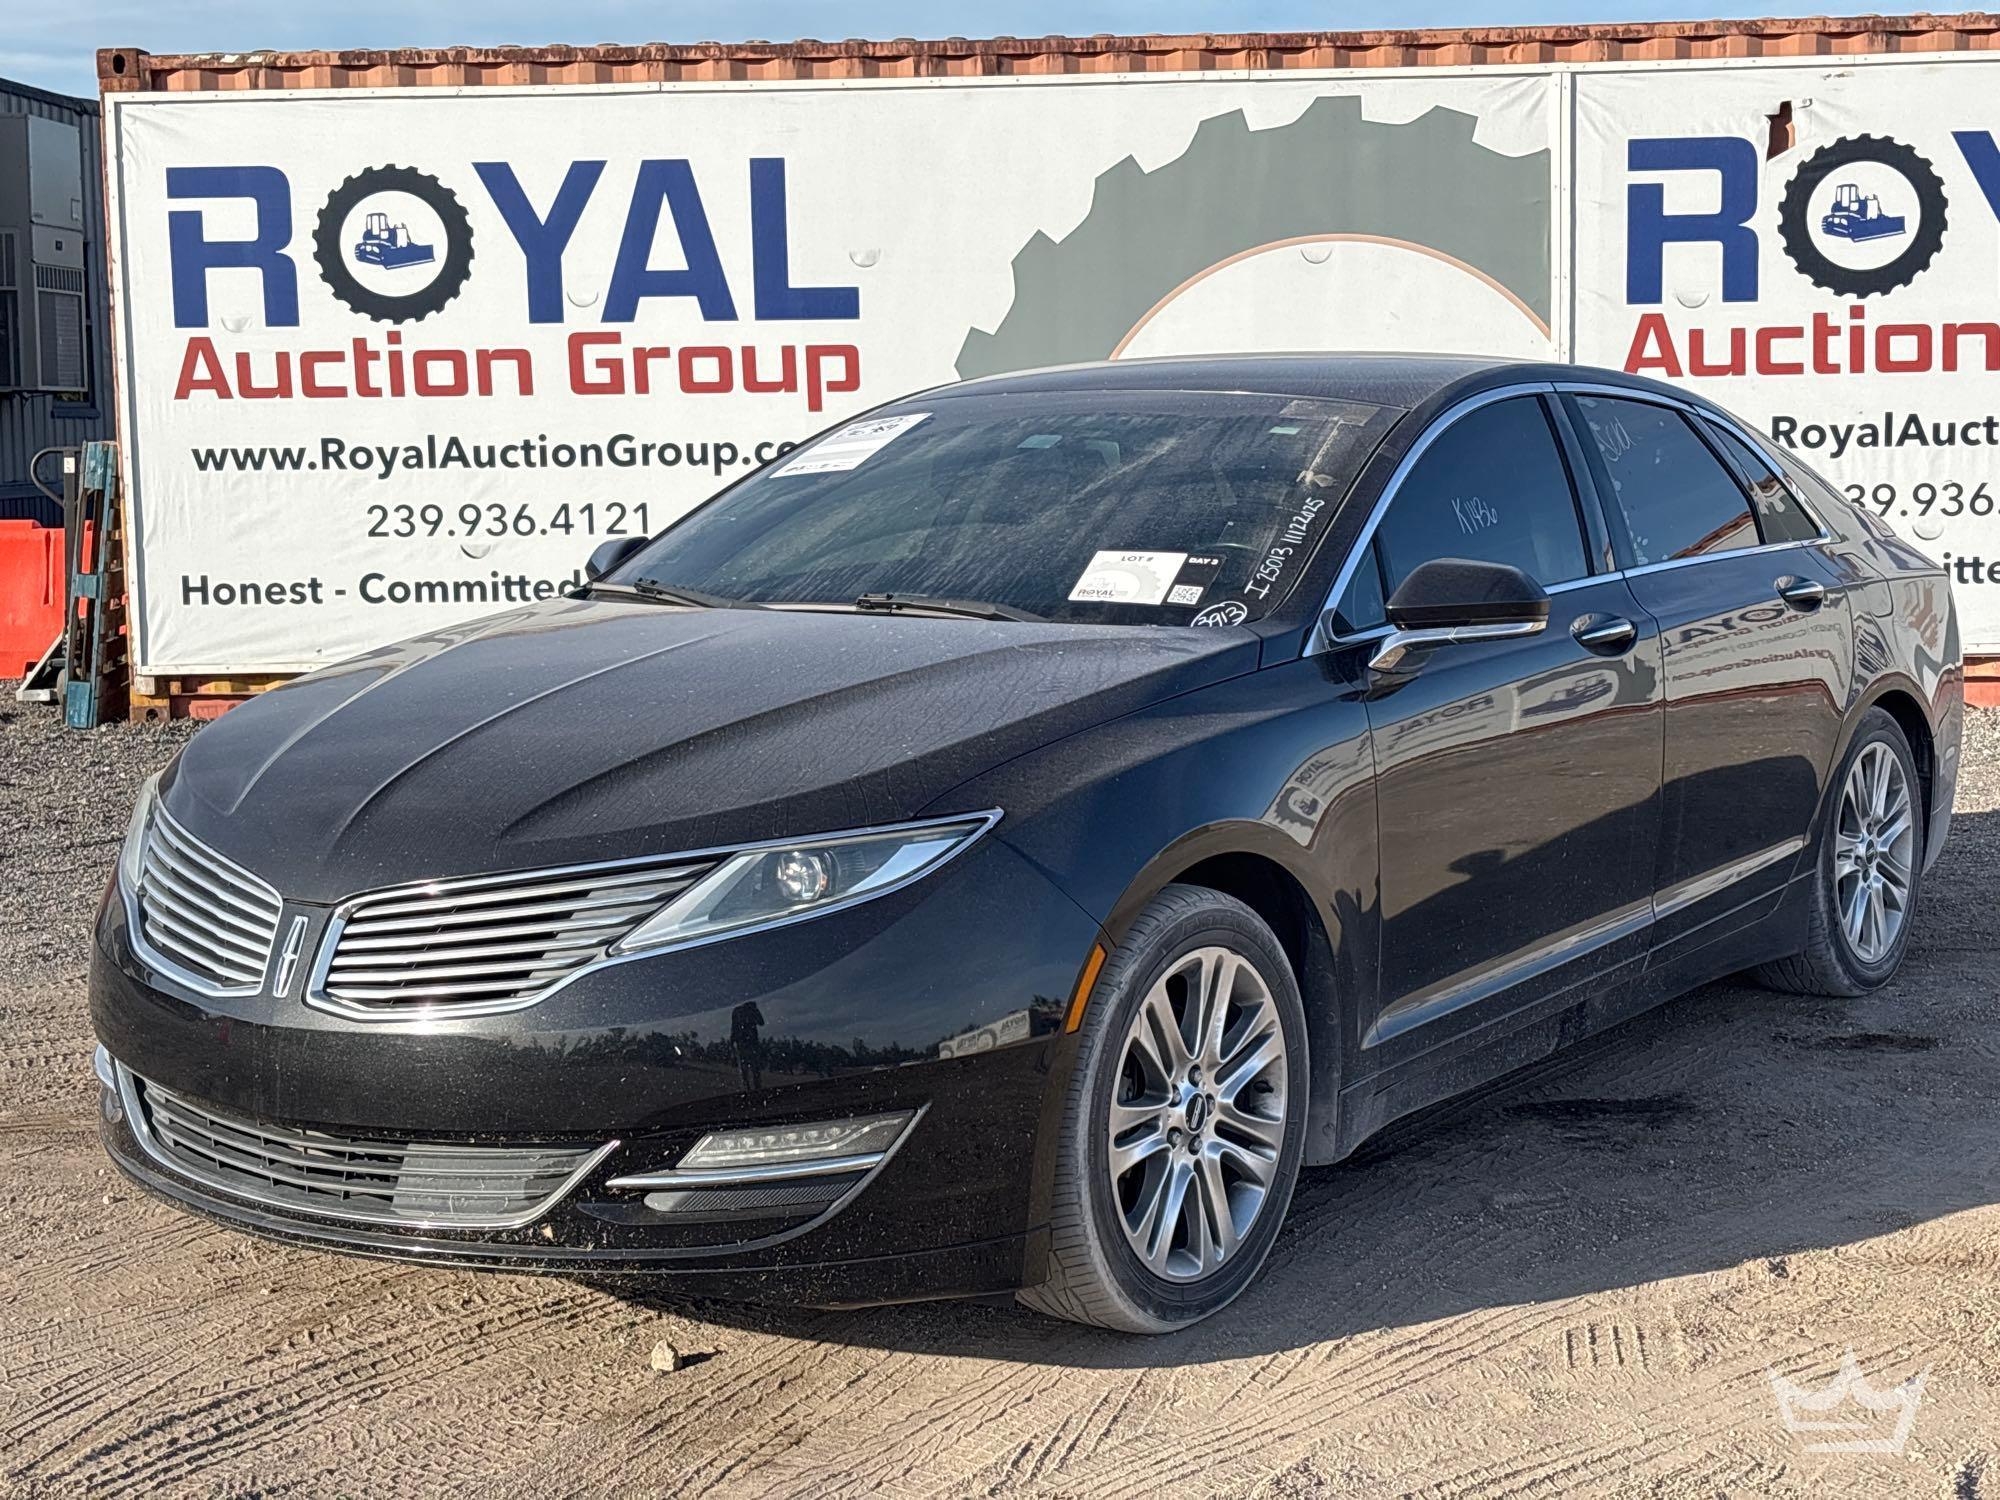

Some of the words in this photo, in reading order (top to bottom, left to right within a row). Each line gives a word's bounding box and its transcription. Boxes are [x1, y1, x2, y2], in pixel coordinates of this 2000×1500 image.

[166, 157, 860, 328] ROYAL
[1624, 305, 2000, 377] Auction
[175, 331, 534, 400] Auction
[568, 331, 860, 412] Group
[367, 501, 650, 538] 239.936.4121
[1121, 555, 1145, 563] LOT
[1188, 557, 1210, 565] DAY
[181, 575, 323, 606] Honest
[358, 569, 581, 604] Committed
